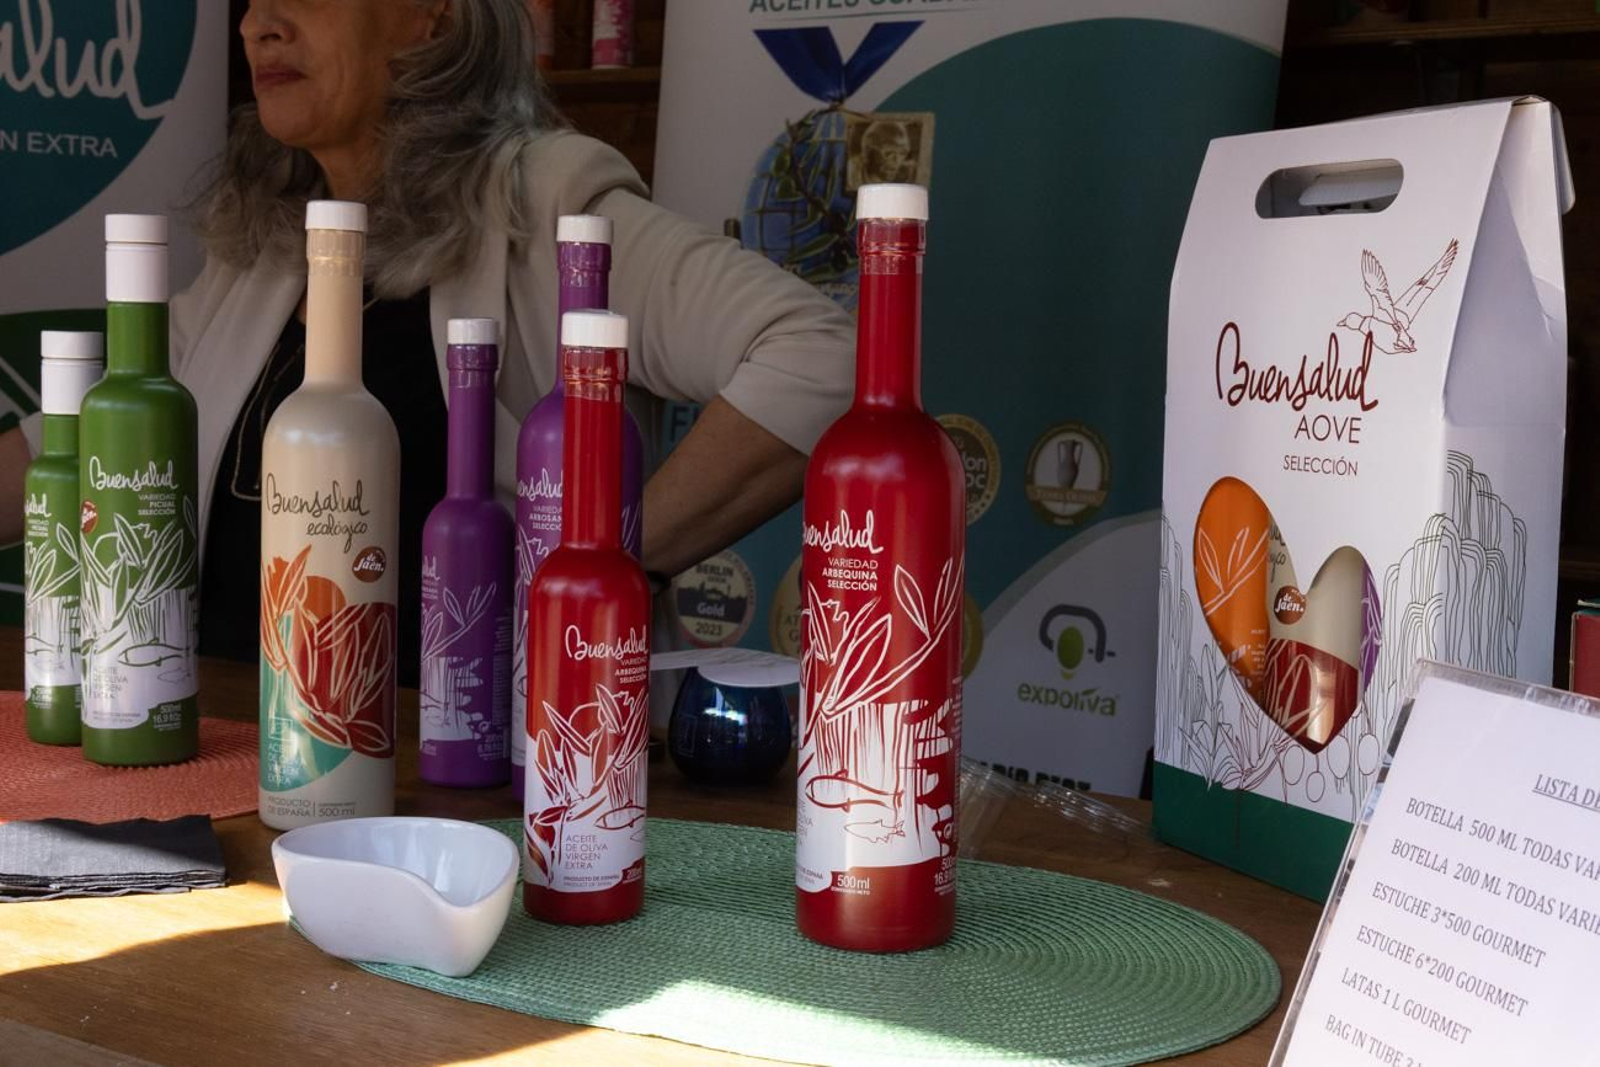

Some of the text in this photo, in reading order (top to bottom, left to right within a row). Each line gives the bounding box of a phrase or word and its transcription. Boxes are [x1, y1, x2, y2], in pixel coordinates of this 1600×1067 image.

[28, 131, 118, 158] EXTRA
[1216, 321, 1379, 412] Buensalud
[1294, 414, 1362, 444] AOVE
[89, 455, 180, 491] Buensalud
[1283, 454, 1359, 477] SELECCIÓN
[266, 472, 371, 518] Buensalud
[307, 513, 368, 554] ecológico
[822, 568, 878, 581] ARBEQUINA
[827, 557, 878, 569] VARIEDAD
[827, 579, 878, 592] SELECCIÓN
[696, 602, 725, 617] Gold
[565, 624, 648, 661] Buensalud
[1017, 682, 1116, 717] expoliva
[1534, 774, 1579, 803] LISTA
[566, 834, 597, 843] ACEITE
[566, 843, 609, 852] DE OLIVA
[1406, 797, 1464, 832] BOTELLA
[1469, 819, 1496, 842] 500
[1497, 829, 1518, 851] ML
[1522, 837, 1573, 870] TODAS
[565, 852, 601, 861] VIRGEN
[565, 861, 593, 870] EXTRA
[1391, 838, 1450, 875] BOTELLA
[1453, 862, 1480, 887] 200
[1481, 872, 1502, 896] ML
[1506, 881, 1556, 916] TODAS
[1372, 881, 1432, 919] ESTUCHE
[1473, 924, 1547, 968] GOURMET
[1356, 925, 1415, 965] ESTUCHE
[1456, 971, 1529, 1017] GOURMET
[1341, 967, 1382, 1000] LATAS
[1391, 993, 1400, 1011] L
[1403, 998, 1472, 1045] GOURMET
[1325, 1014, 1352, 1040] BAG
[1351, 1028, 1367, 1049] IN
[1368, 1036, 1404, 1067] TUBE
